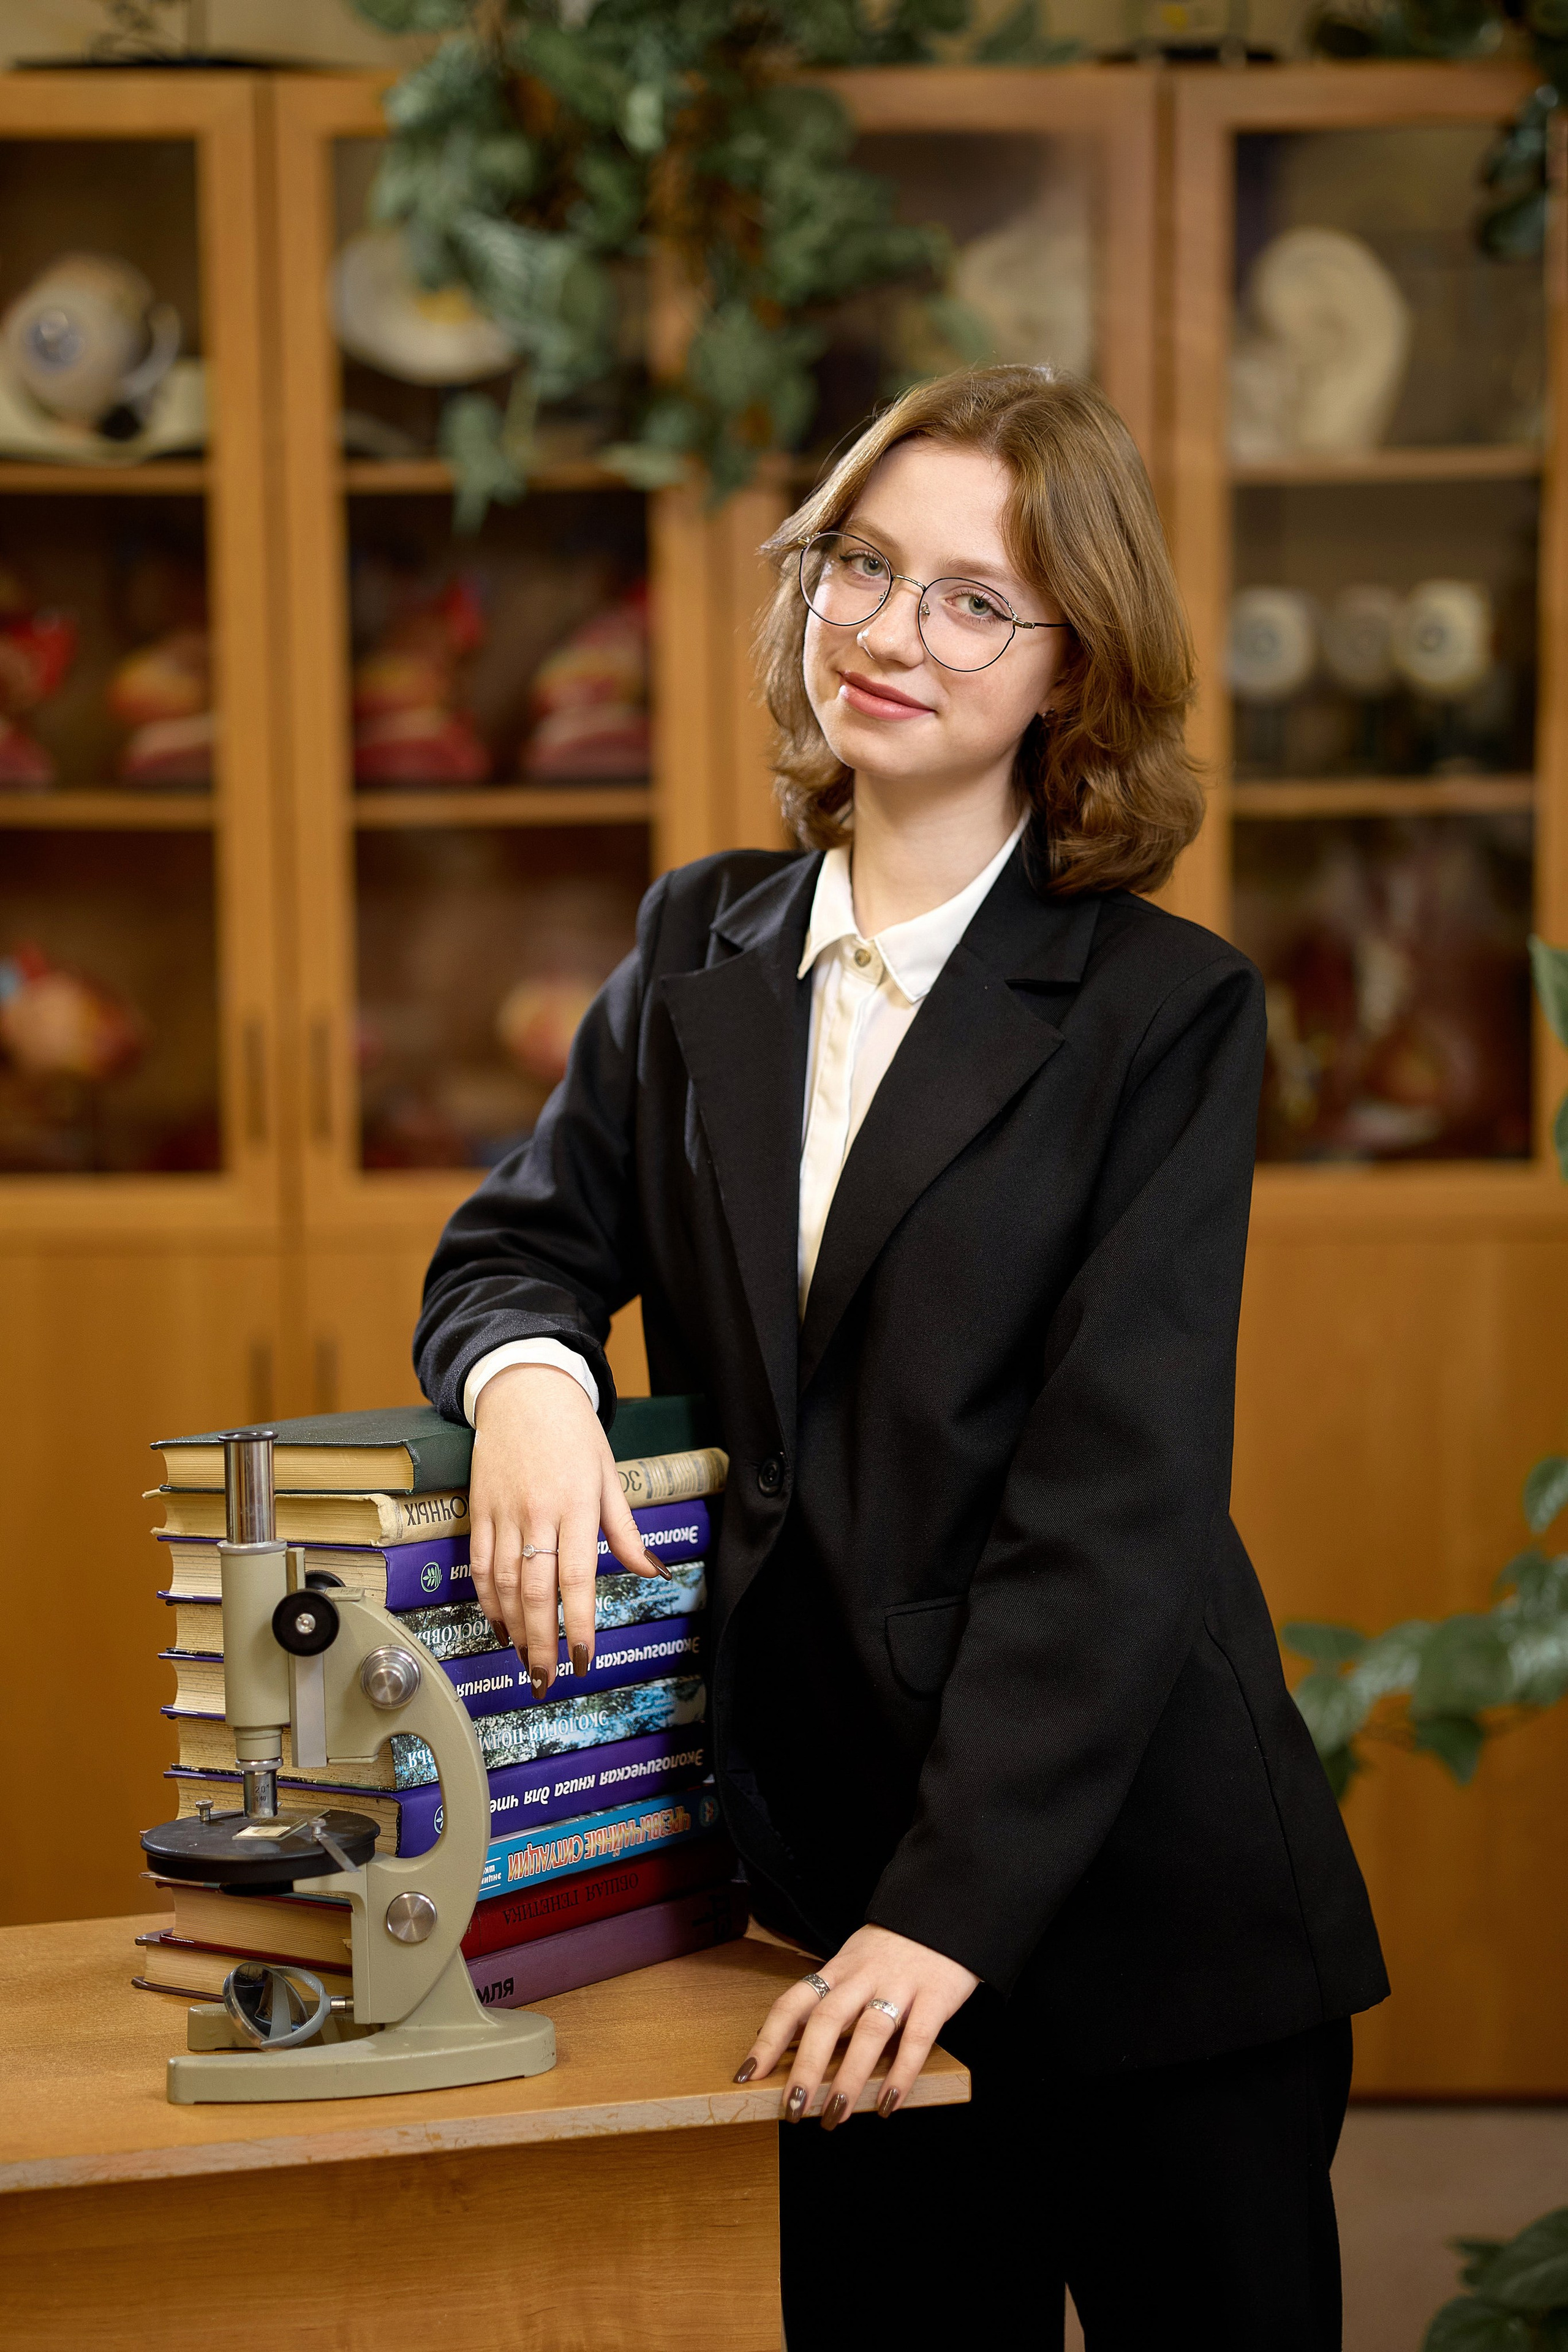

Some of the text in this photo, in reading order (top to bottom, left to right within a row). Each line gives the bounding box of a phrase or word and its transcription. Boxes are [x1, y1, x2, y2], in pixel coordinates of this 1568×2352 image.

[404, 1494, 470, 1526] ОЧНЫХ
[595, 1636, 701, 1670] Экологическая
[456, 1674, 513, 1697] чтения
[528, 1709, 609, 1741] ЭКОЛОГИЯ
[598, 1749, 704, 1786] Экологическая
[523, 1785, 551, 1805] для
[554, 1774, 596, 1797] книга
[507, 1806, 691, 1882] ЧРЕЗВЫЧАЙНЫЕ СИТУАЦИИ
[503, 1872, 639, 1925] ОБЩАЯ ГЕНЕТИКА
